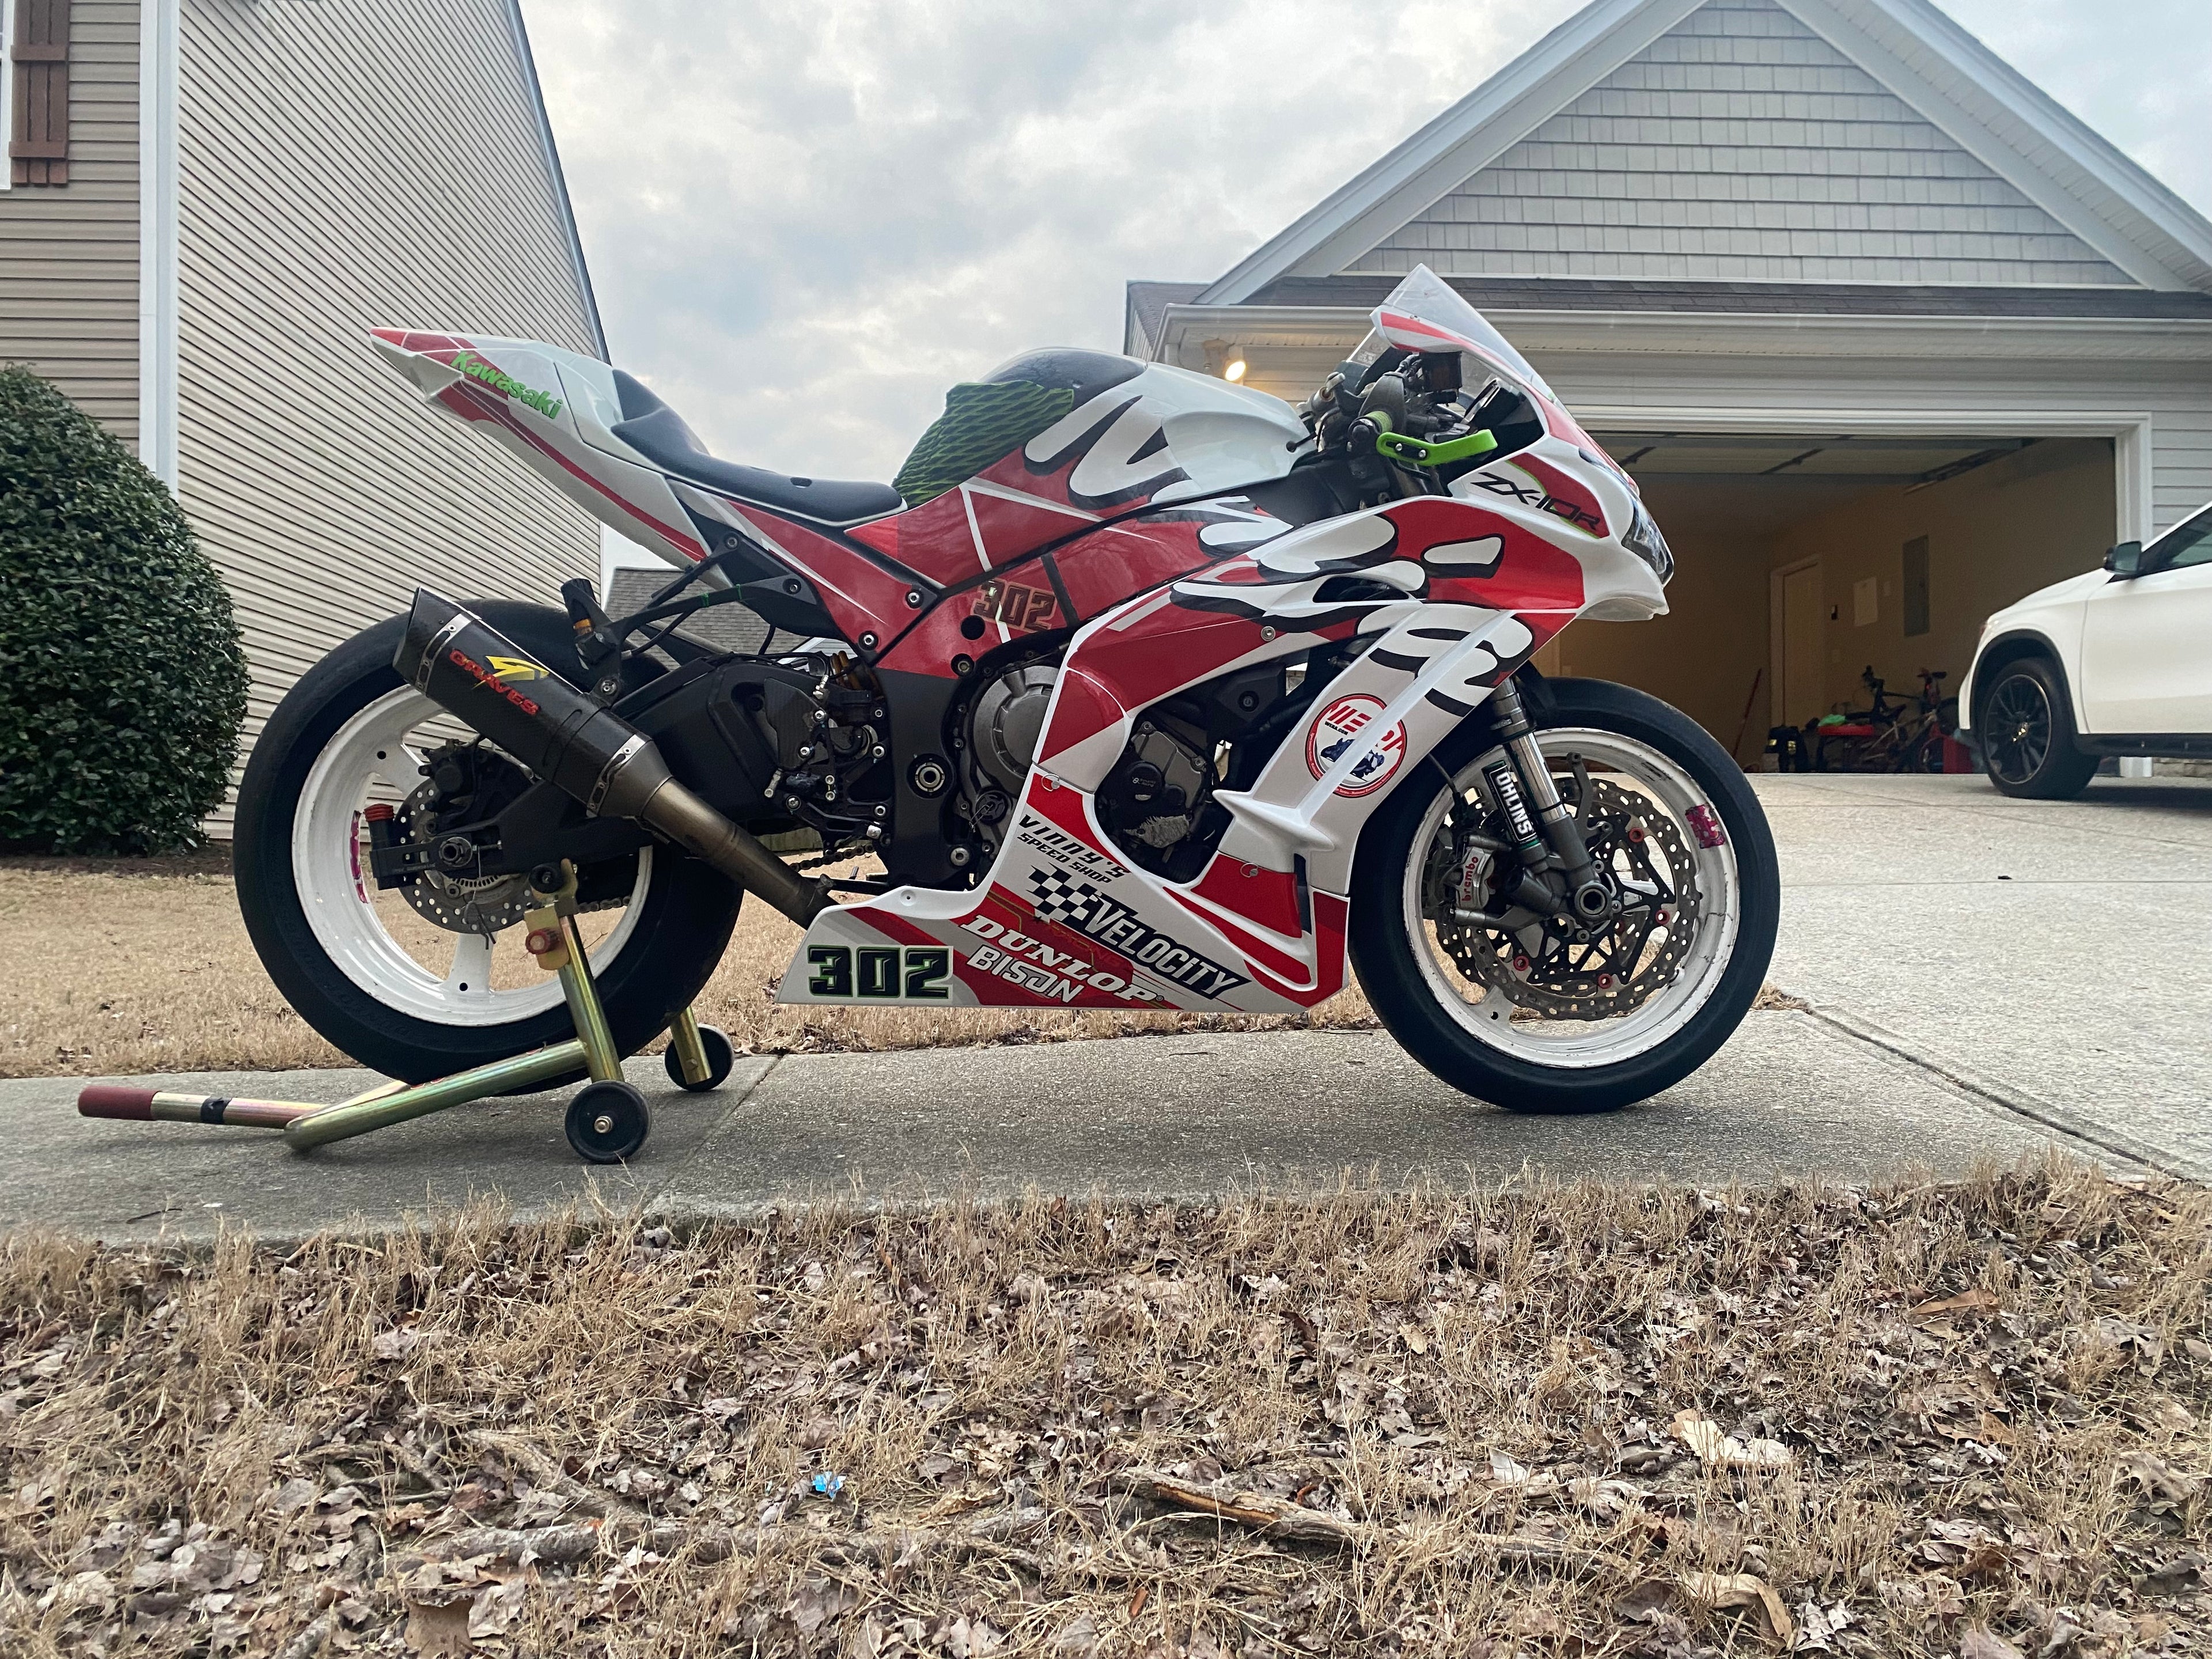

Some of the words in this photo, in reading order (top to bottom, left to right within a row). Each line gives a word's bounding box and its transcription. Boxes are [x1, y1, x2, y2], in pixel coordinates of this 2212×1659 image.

[450, 351, 563, 419] Kawasaki
[1470, 472, 1600, 530] ZX-10R
[972, 579, 1056, 632] 302
[449, 649, 539, 715] GRAVES
[1017, 832, 1071, 863] SPEED
[1069, 861, 1112, 883] SHOP
[1461, 857, 1479, 901] brembo
[807, 945, 949, 999] 302
[967, 945, 1085, 1003] BISON
